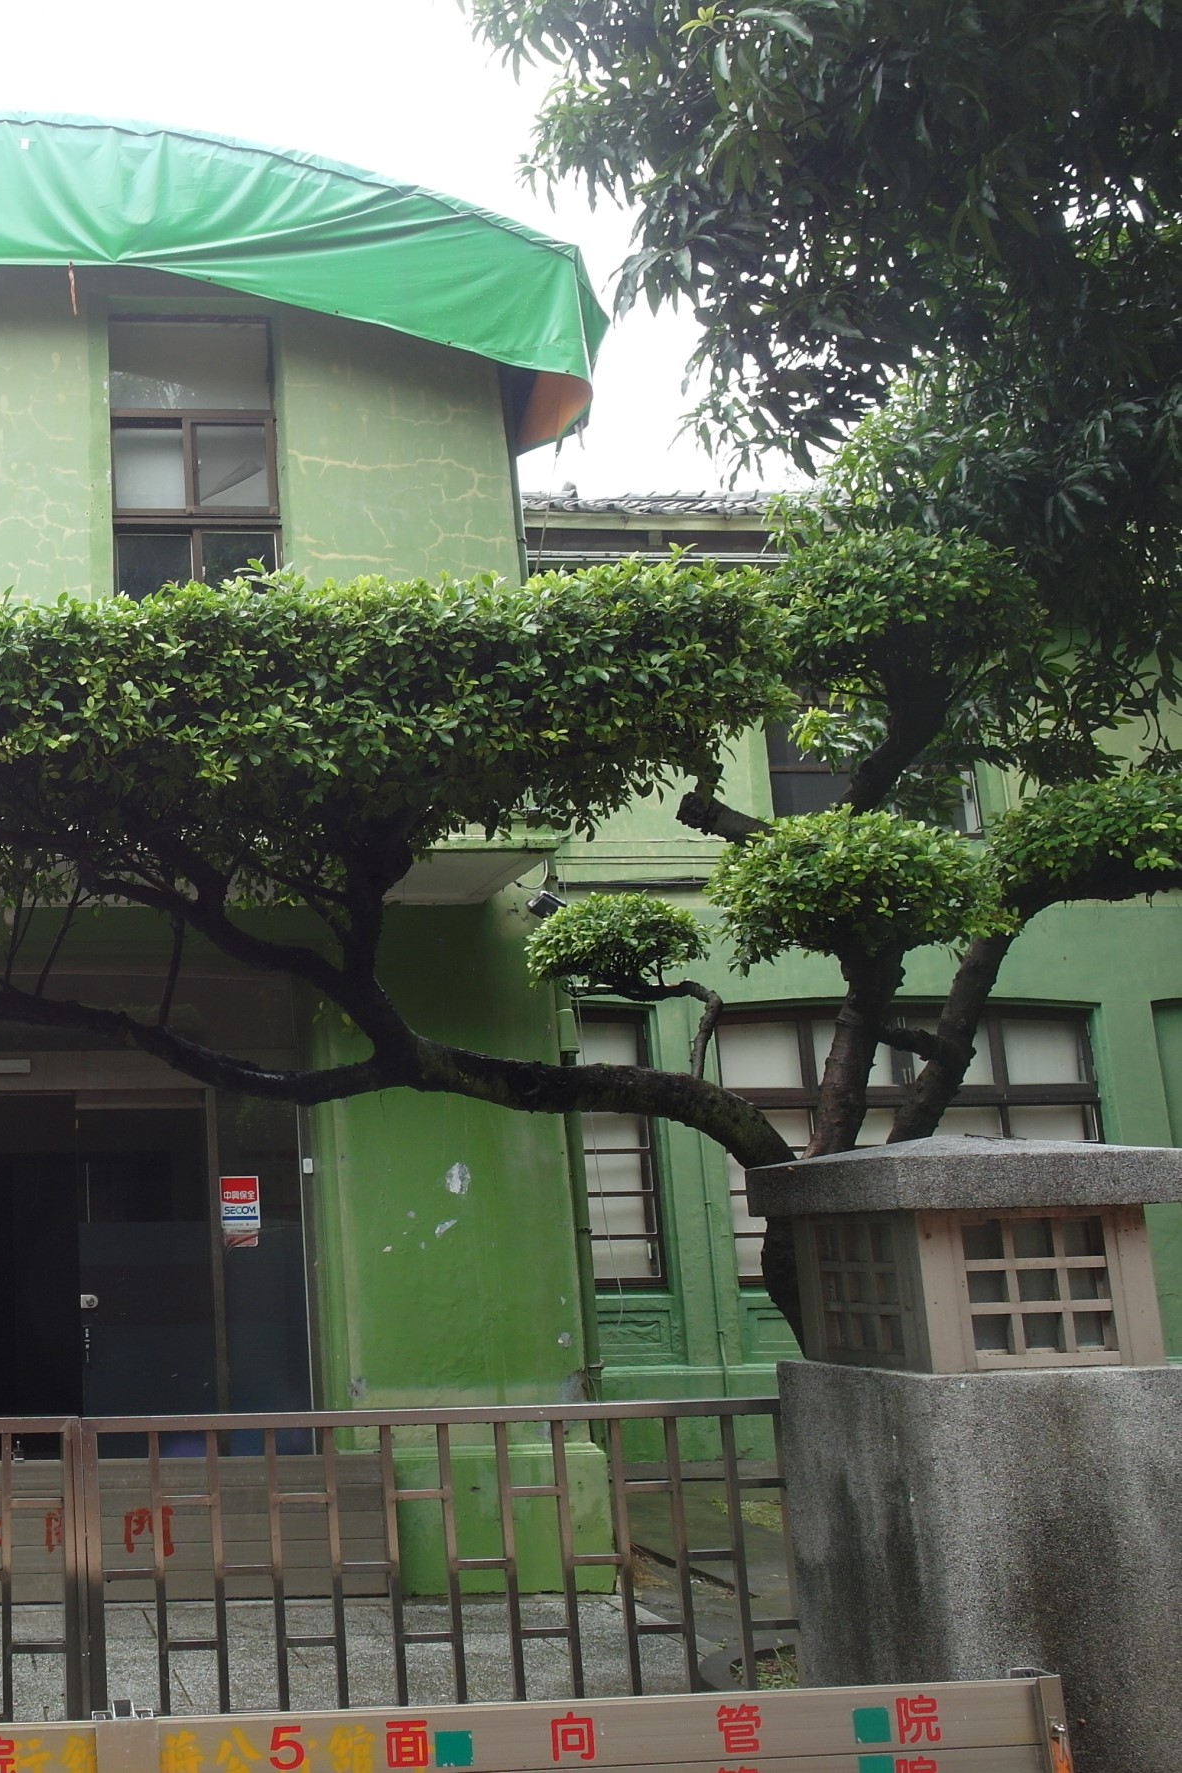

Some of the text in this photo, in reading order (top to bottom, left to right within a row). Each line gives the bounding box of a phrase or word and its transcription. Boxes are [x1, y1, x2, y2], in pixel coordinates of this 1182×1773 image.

[224, 1206, 256, 1215] SECOM
[269, 1695, 941, 1770] 5 面 向 管 院
